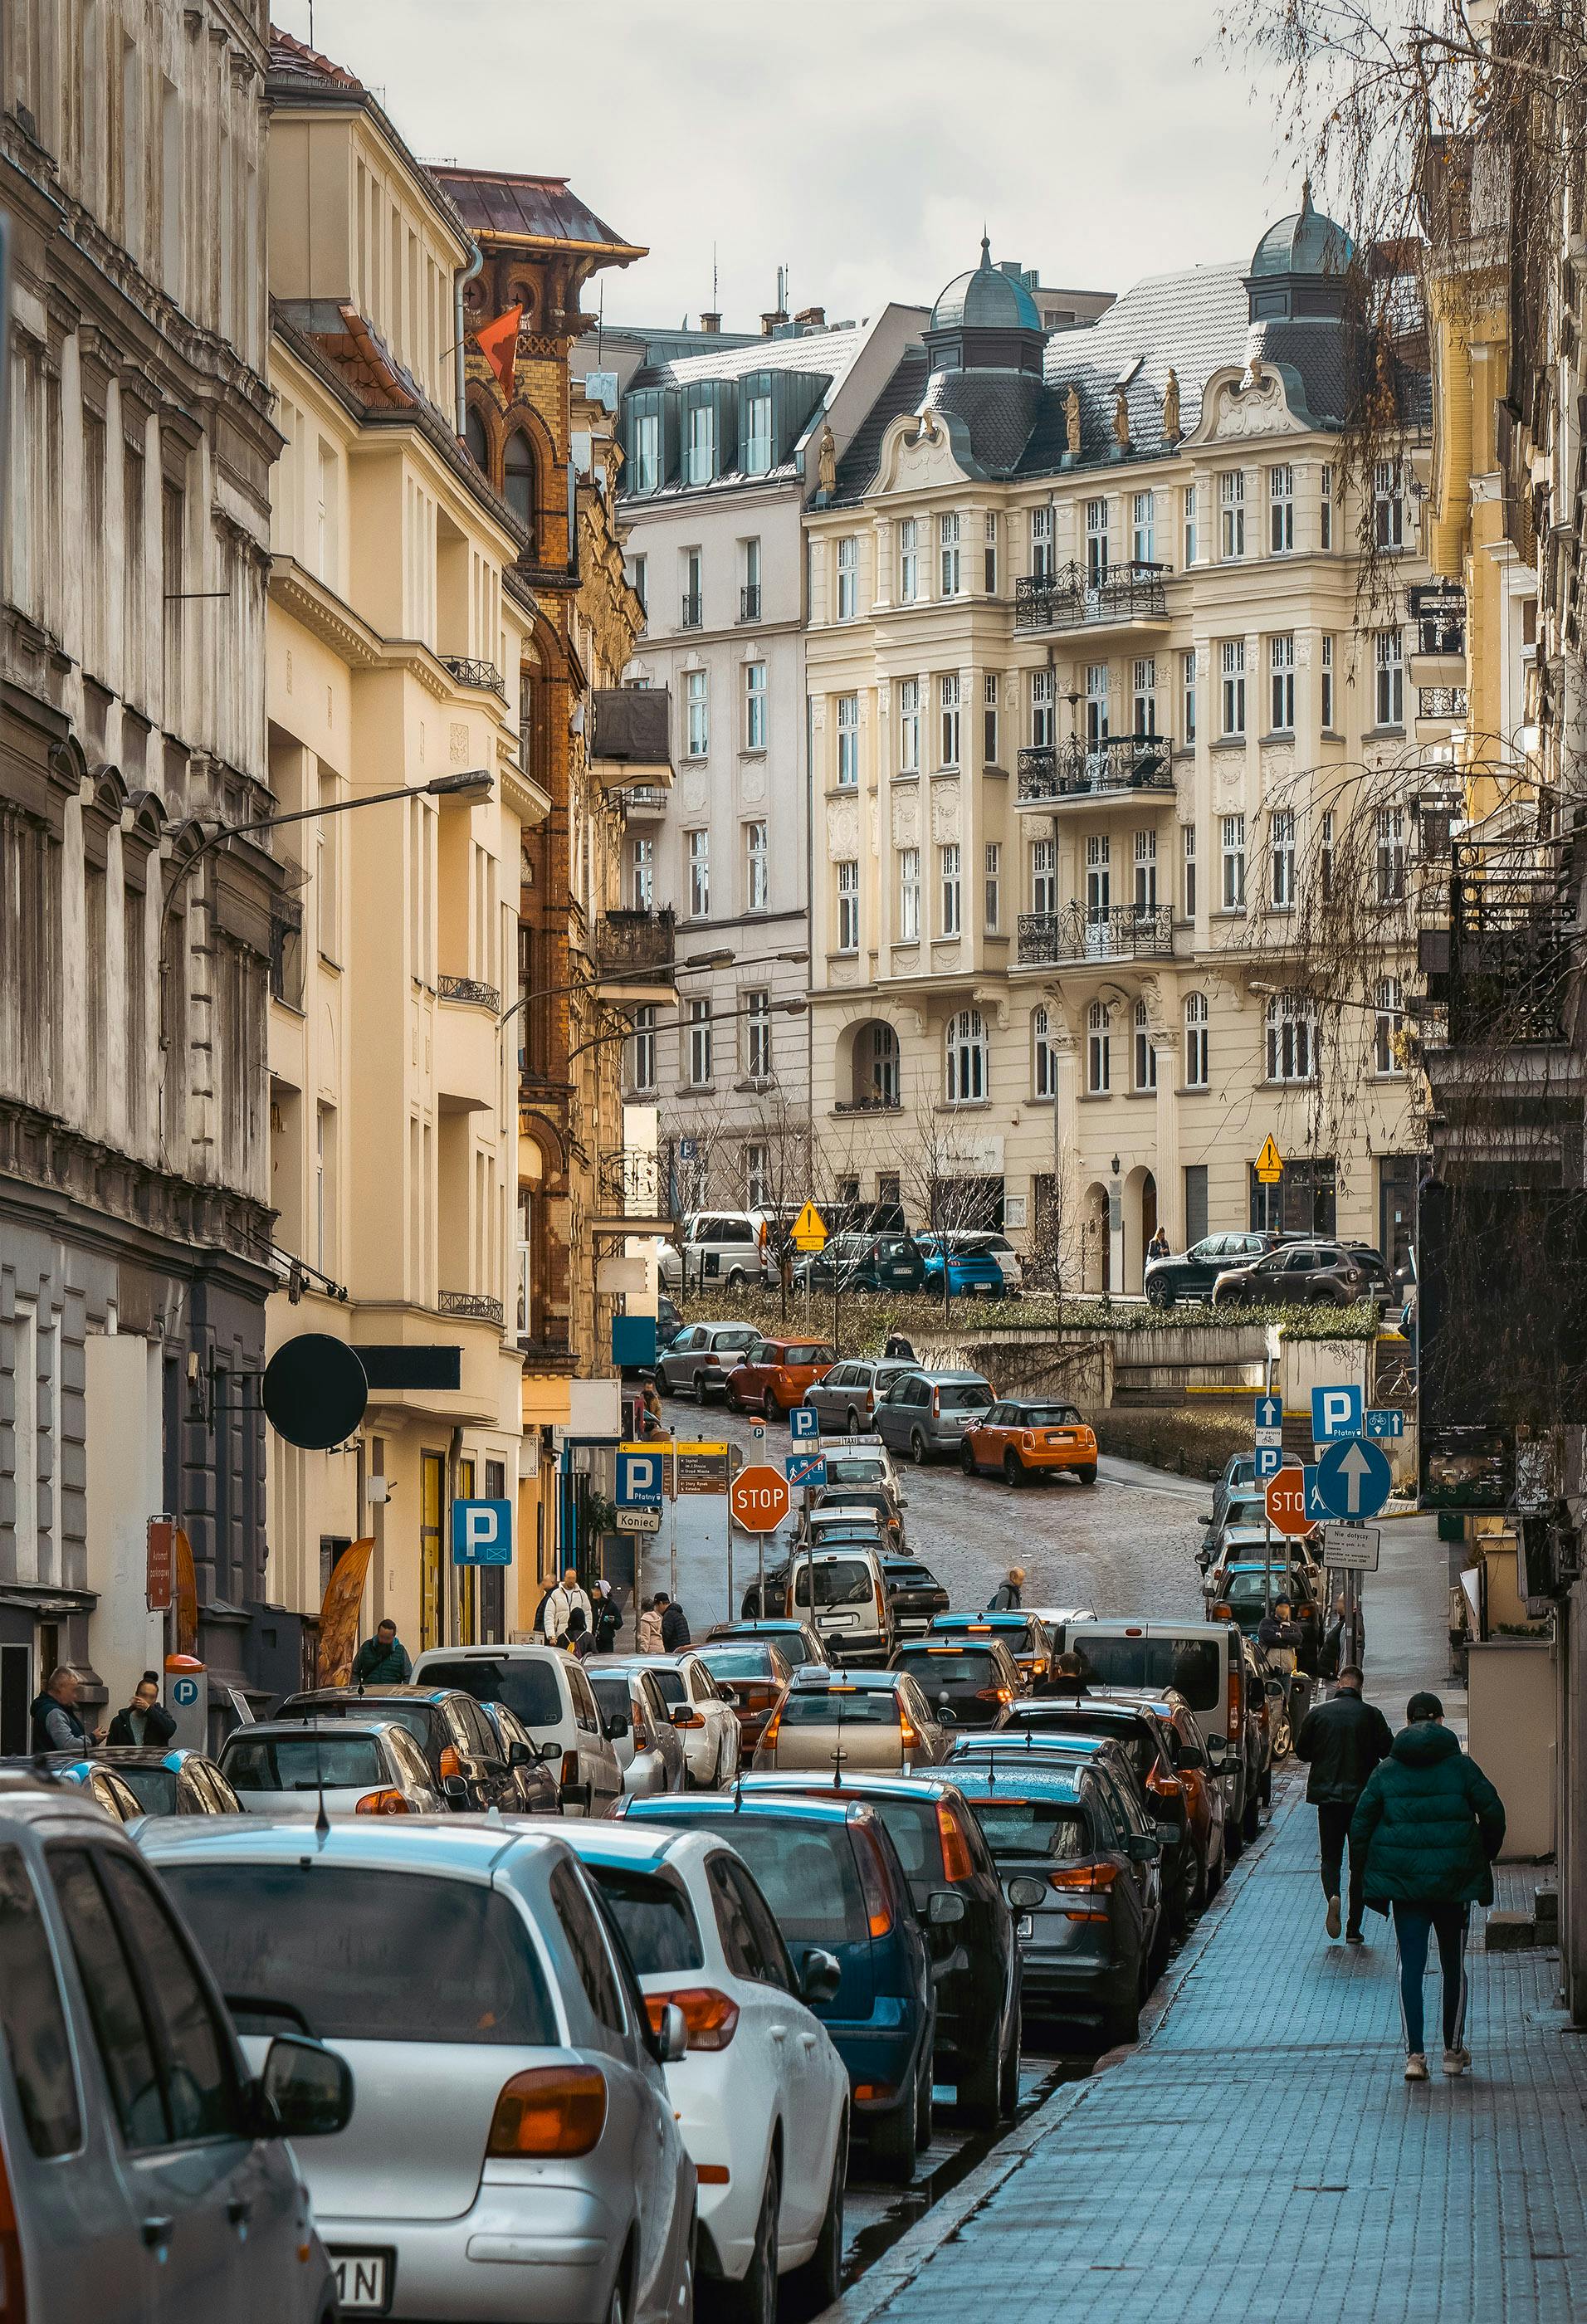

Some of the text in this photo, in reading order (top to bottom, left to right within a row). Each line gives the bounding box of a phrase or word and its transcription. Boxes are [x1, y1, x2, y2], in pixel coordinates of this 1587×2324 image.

[797, 1411, 813, 1435] P
[1323, 1392, 1351, 1435] P
[755, 1428, 763, 1438] P
[1261, 1450, 1277, 1473] P
[626, 1458, 653, 1500] P
[634, 1492, 656, 1501] Płatny
[737, 1488, 784, 1509] STOP
[1272, 1492, 1304, 1511] STO
[621, 1515, 654, 1527] Koniec
[466, 1507, 498, 1557] P
[179, 1682, 193, 1702] P
